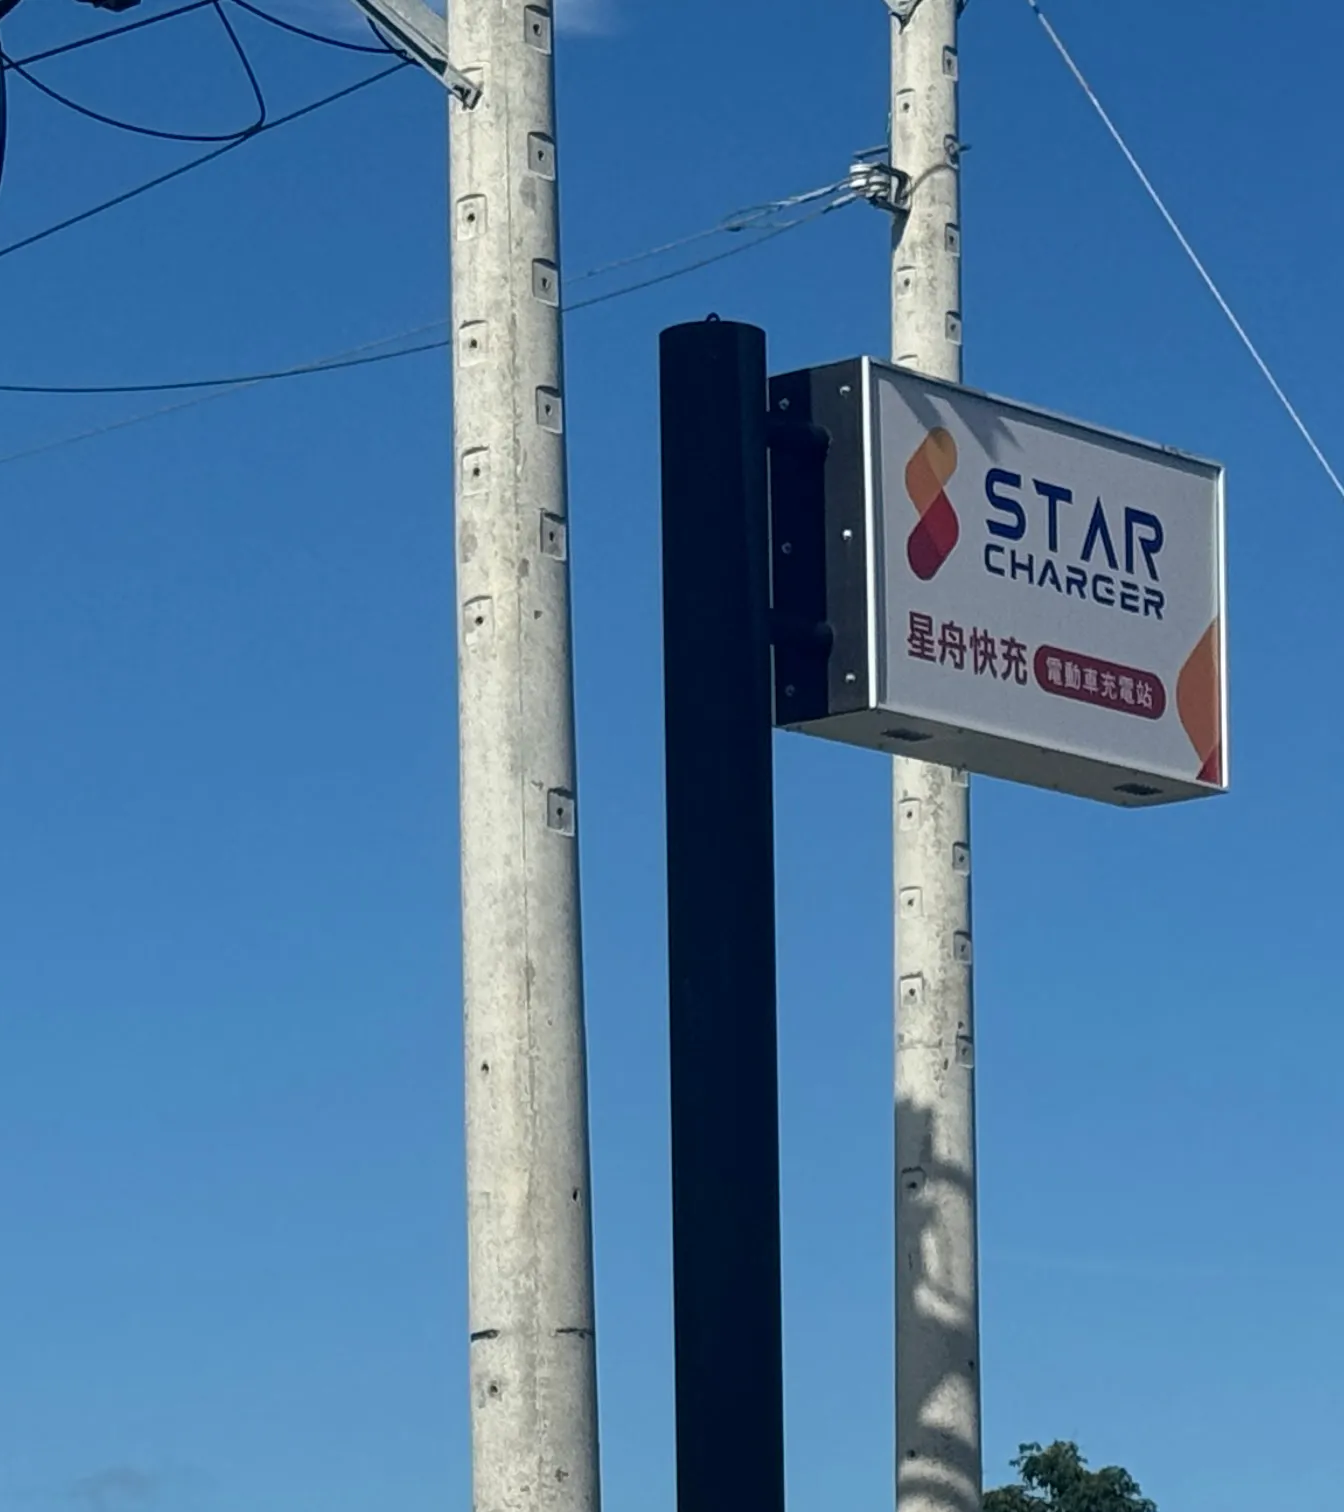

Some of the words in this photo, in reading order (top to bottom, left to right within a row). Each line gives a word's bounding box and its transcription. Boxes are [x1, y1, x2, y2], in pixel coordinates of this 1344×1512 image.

[985, 467, 1165, 581] STAR
[984, 543, 1166, 620] CHARGER
[906, 611, 1028, 686] 星舟快充
[1045, 656, 1154, 709] 電動車充電站
